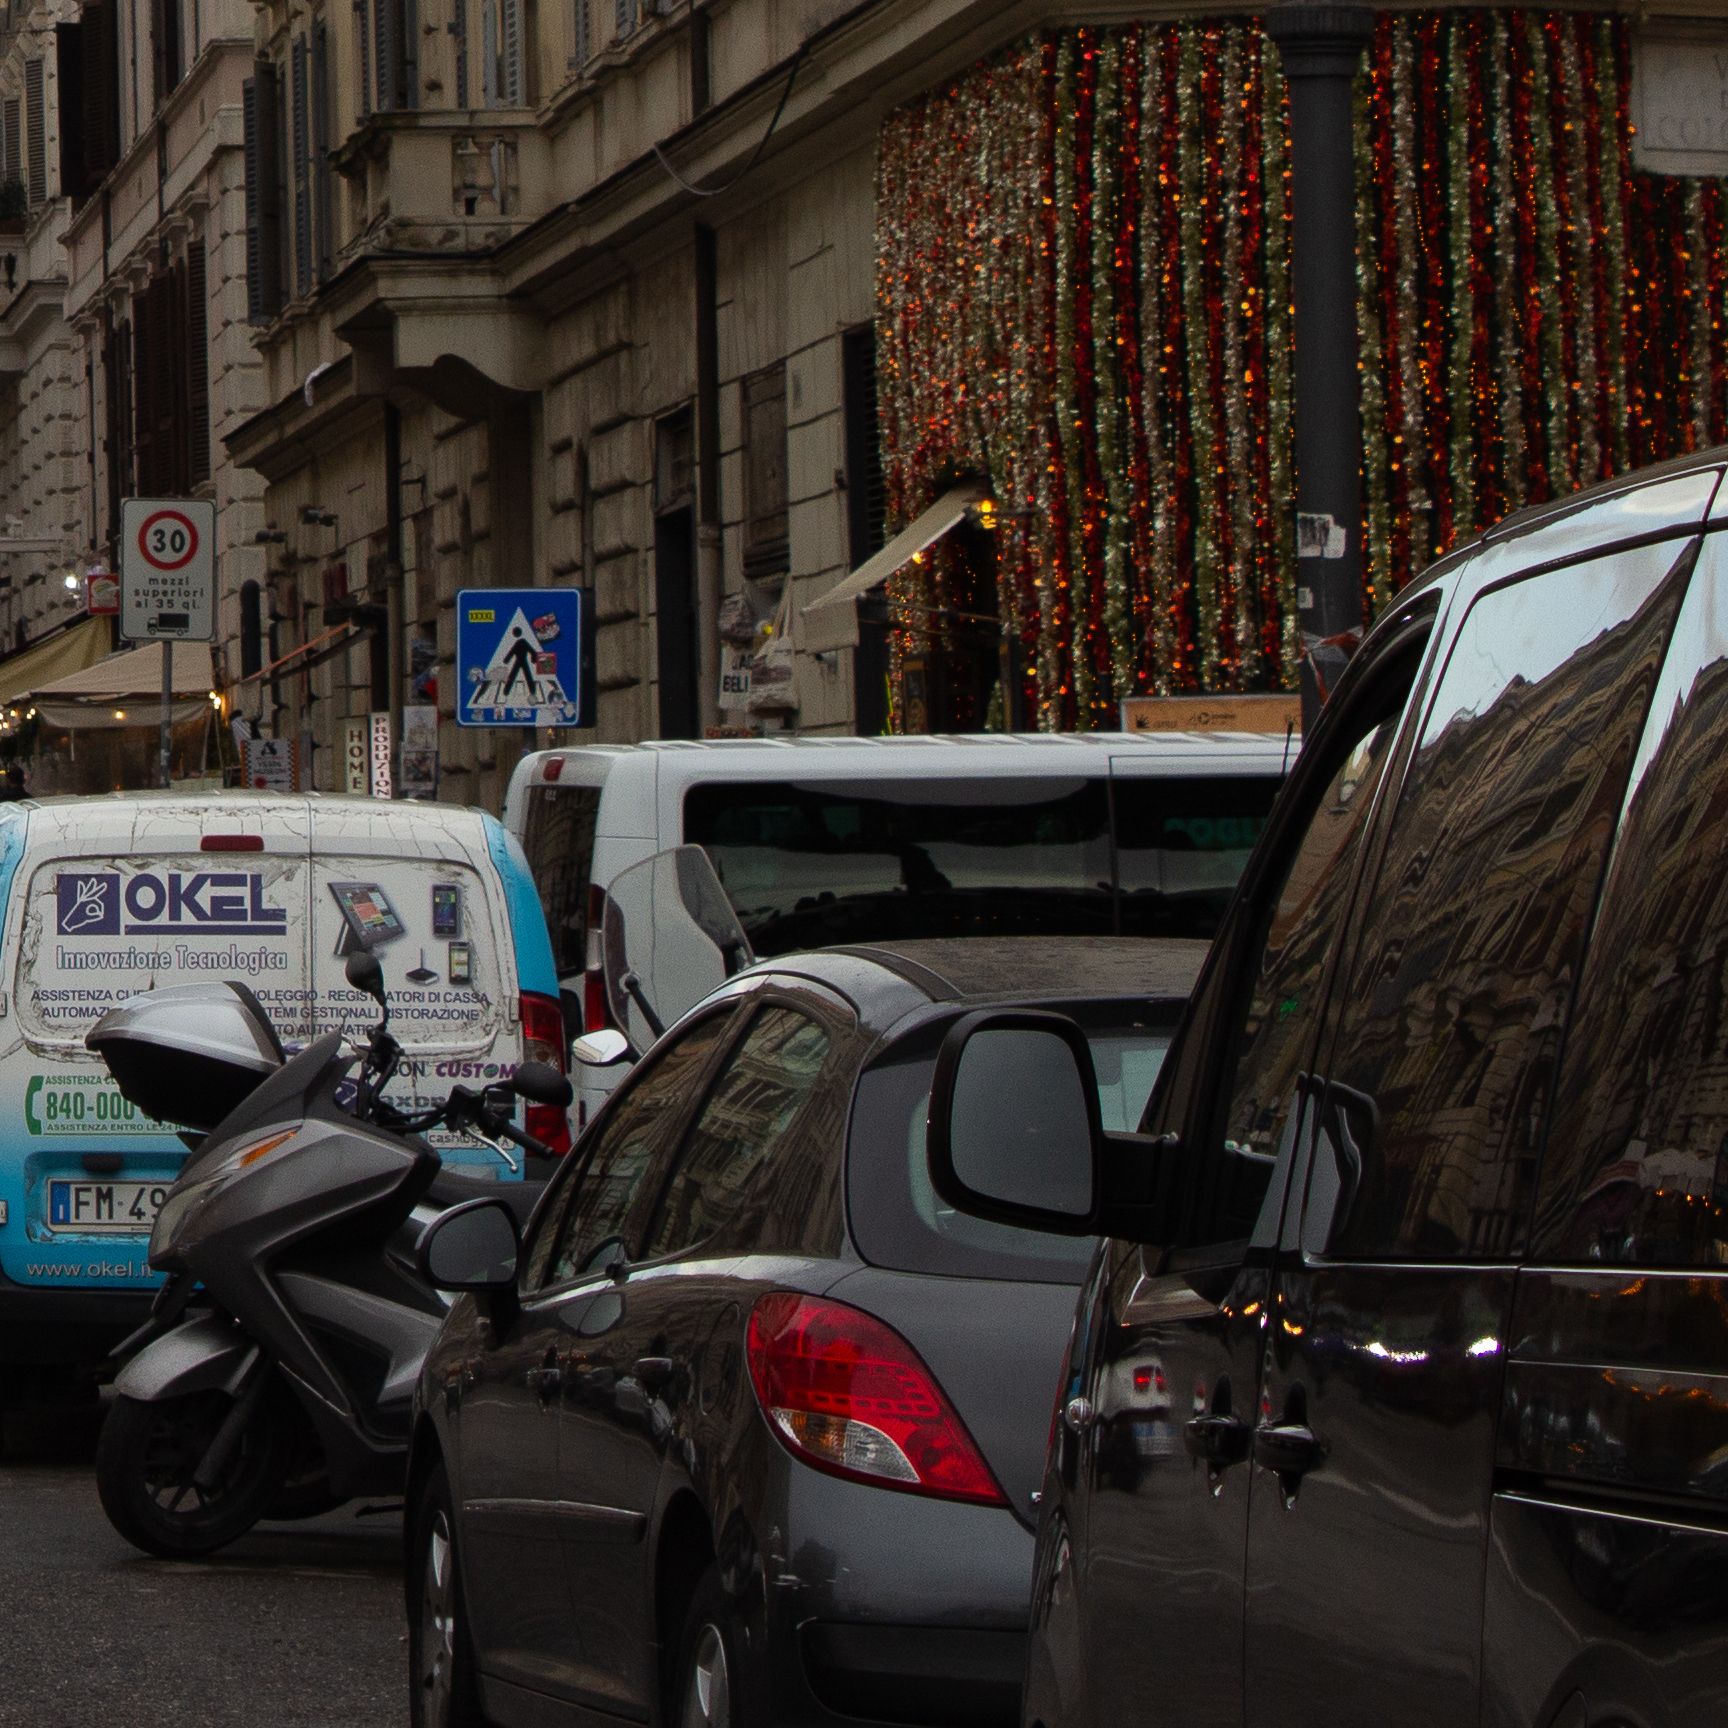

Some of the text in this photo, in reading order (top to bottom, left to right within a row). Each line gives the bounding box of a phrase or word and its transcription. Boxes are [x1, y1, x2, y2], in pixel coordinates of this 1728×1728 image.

[152, 529, 185, 553] 30
[149, 576, 189, 586] mezzi
[134, 587, 204, 598] superiori
[156, 599, 174, 608] 35
[349, 729, 364, 789] HOME
[124, 873, 287, 922] OKEL
[56, 944, 288, 975] Innovazione Tecnologica
[31, 990, 112, 1002] ASSISTENZA
[328, 990, 426, 1004] REGISTATORI
[429, 991, 439, 1003] DI
[444, 991, 488, 1005] CASSA
[263, 1007, 297, 1019] TEMI
[300, 1007, 378, 1020] GESTIONALI
[435, 1062, 518, 1079] CUSTOM
[45, 1075, 102, 1085] ASSISTENZA
[47, 1124, 108, 1132] ASSISTENZA
[111, 1124, 144, 1132] ENTRO
[147, 1124, 158, 1132] LE
[74, 1186, 114, 1221] FM
[27, 1260, 153, 1278] www.okel.it
